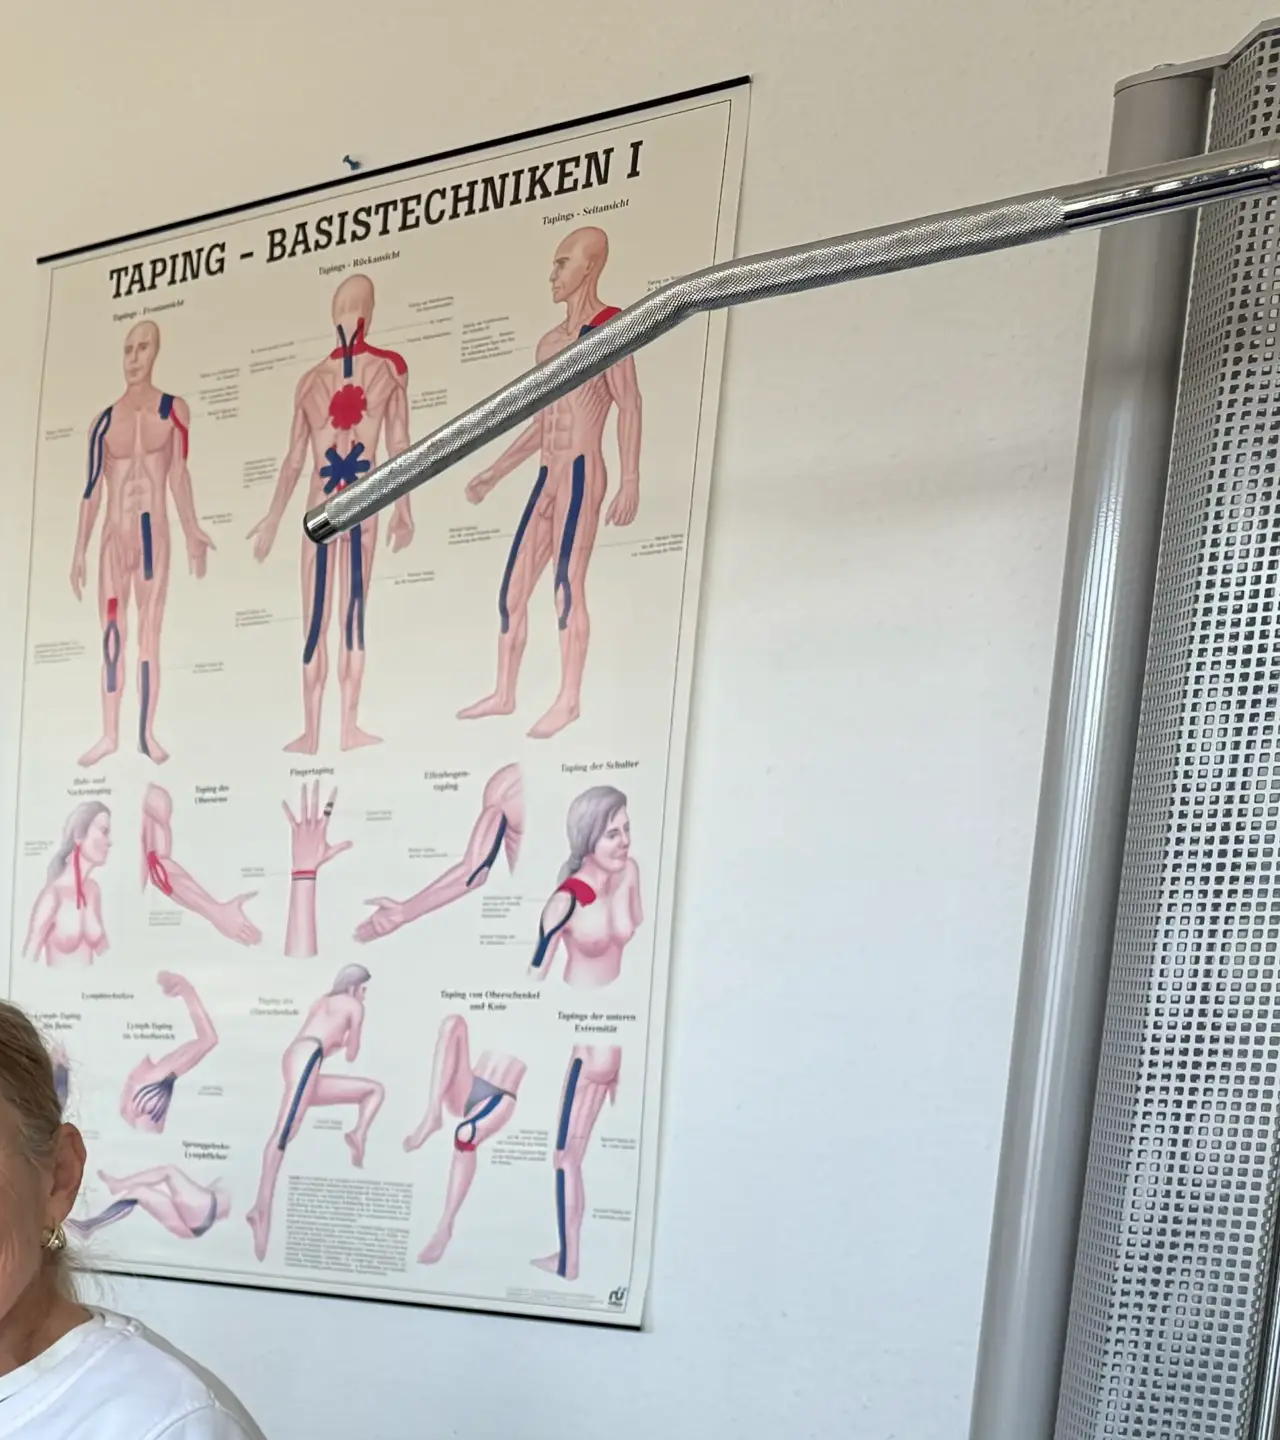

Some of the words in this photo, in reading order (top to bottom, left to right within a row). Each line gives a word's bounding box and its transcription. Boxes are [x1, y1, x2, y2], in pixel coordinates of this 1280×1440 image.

[109, 242, 226, 299] TAPING
[266, 147, 614, 263] BASISTECHNIKEN
[626, 140, 644, 179] I
[542, 211, 575, 226] Tapings
